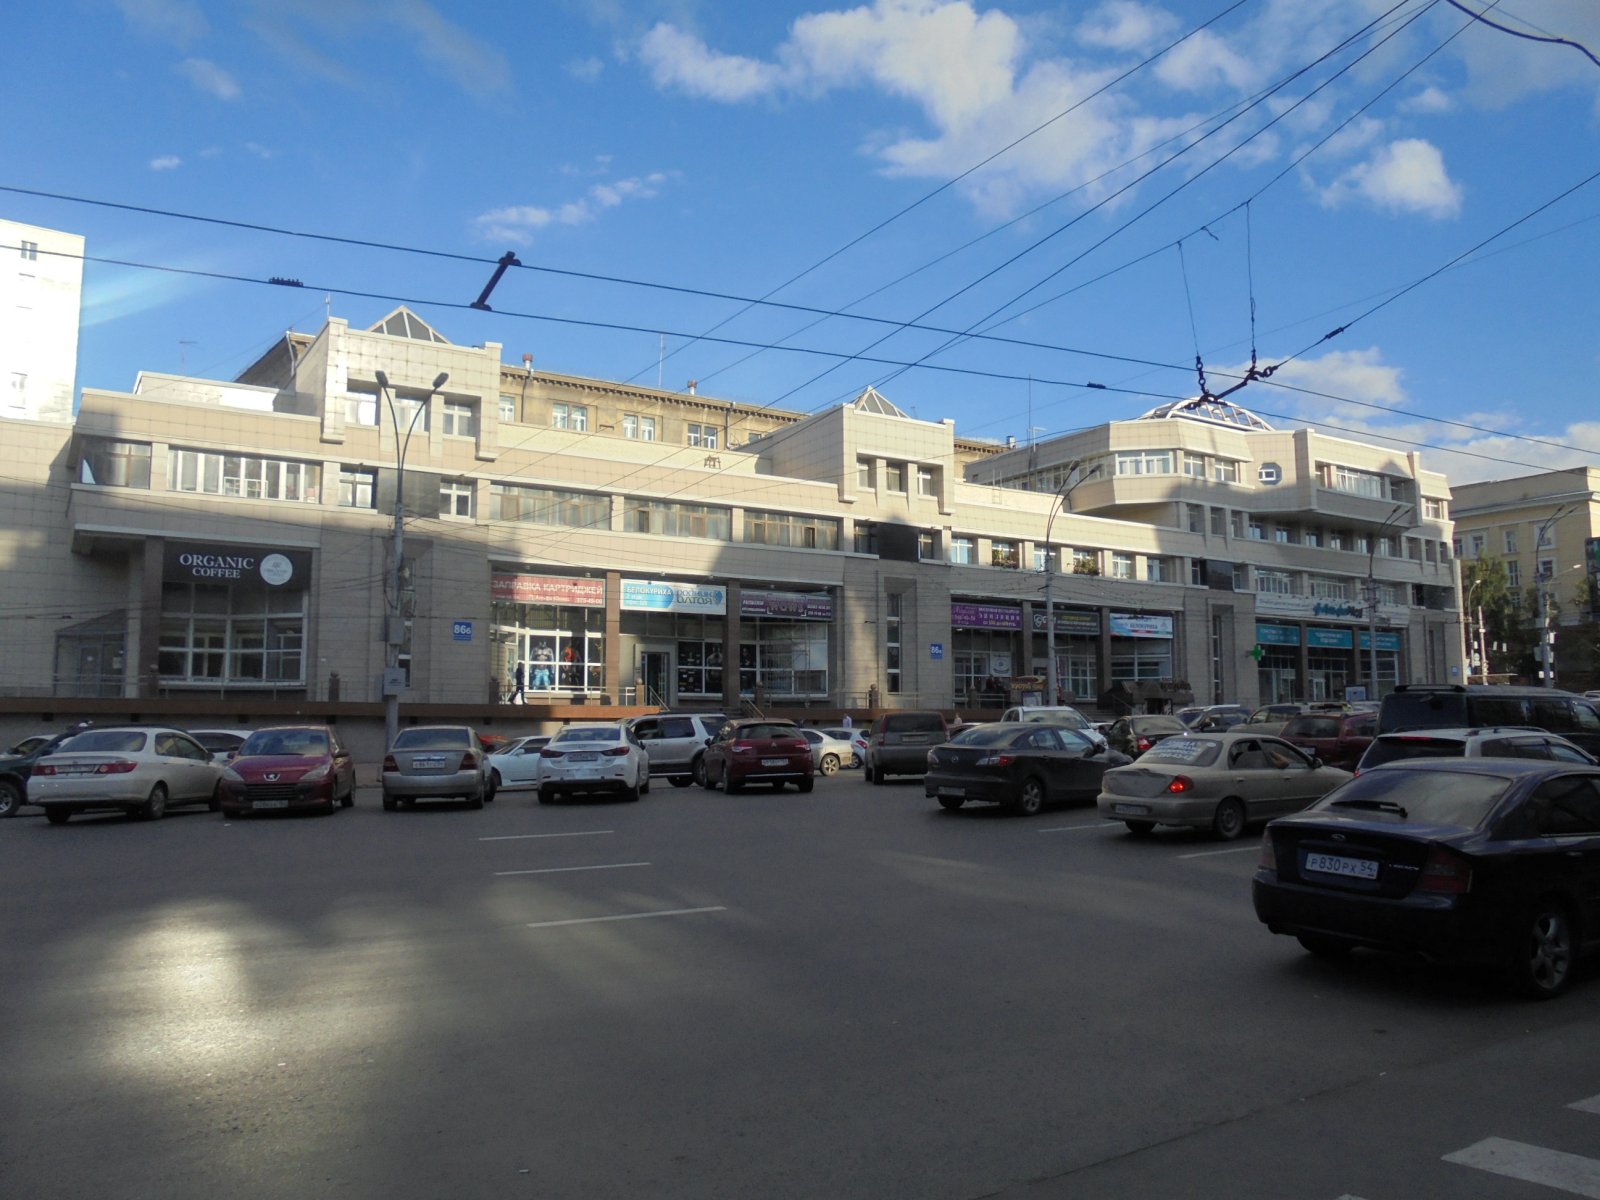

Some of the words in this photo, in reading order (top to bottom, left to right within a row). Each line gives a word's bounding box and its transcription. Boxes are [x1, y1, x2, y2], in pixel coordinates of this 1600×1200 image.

[180, 553, 254, 569] ORGANIC
[192, 566, 241, 579] COFFEE
[492, 579, 541, 592] ЗАПРАВКА
[543, 583, 603, 595] КАРТРИДЖЕЙ
[627, 586, 672, 596] БЕЛОКУРИХА
[454, 624, 471, 635] 86б
